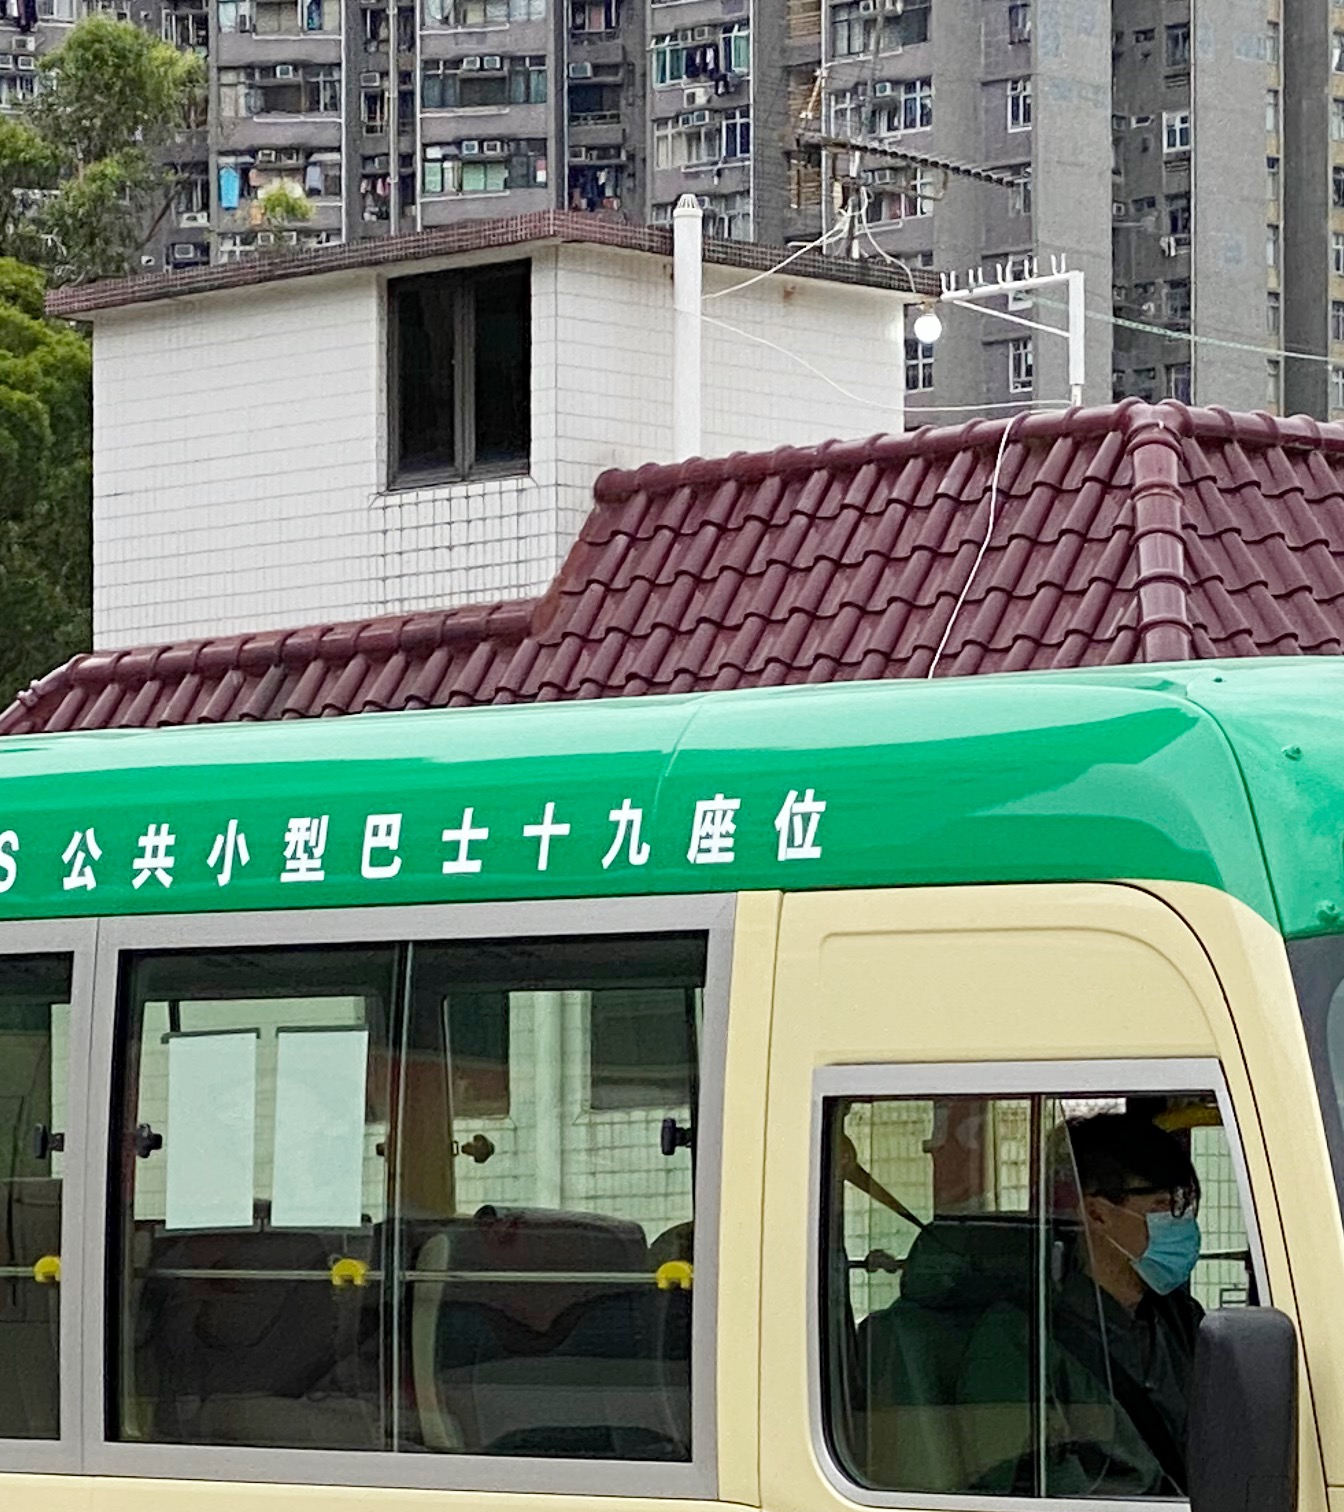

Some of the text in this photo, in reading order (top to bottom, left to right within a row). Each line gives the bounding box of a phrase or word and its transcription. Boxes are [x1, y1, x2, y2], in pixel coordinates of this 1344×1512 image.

[60, 788, 827, 892] 公共小型巴士十九座位
